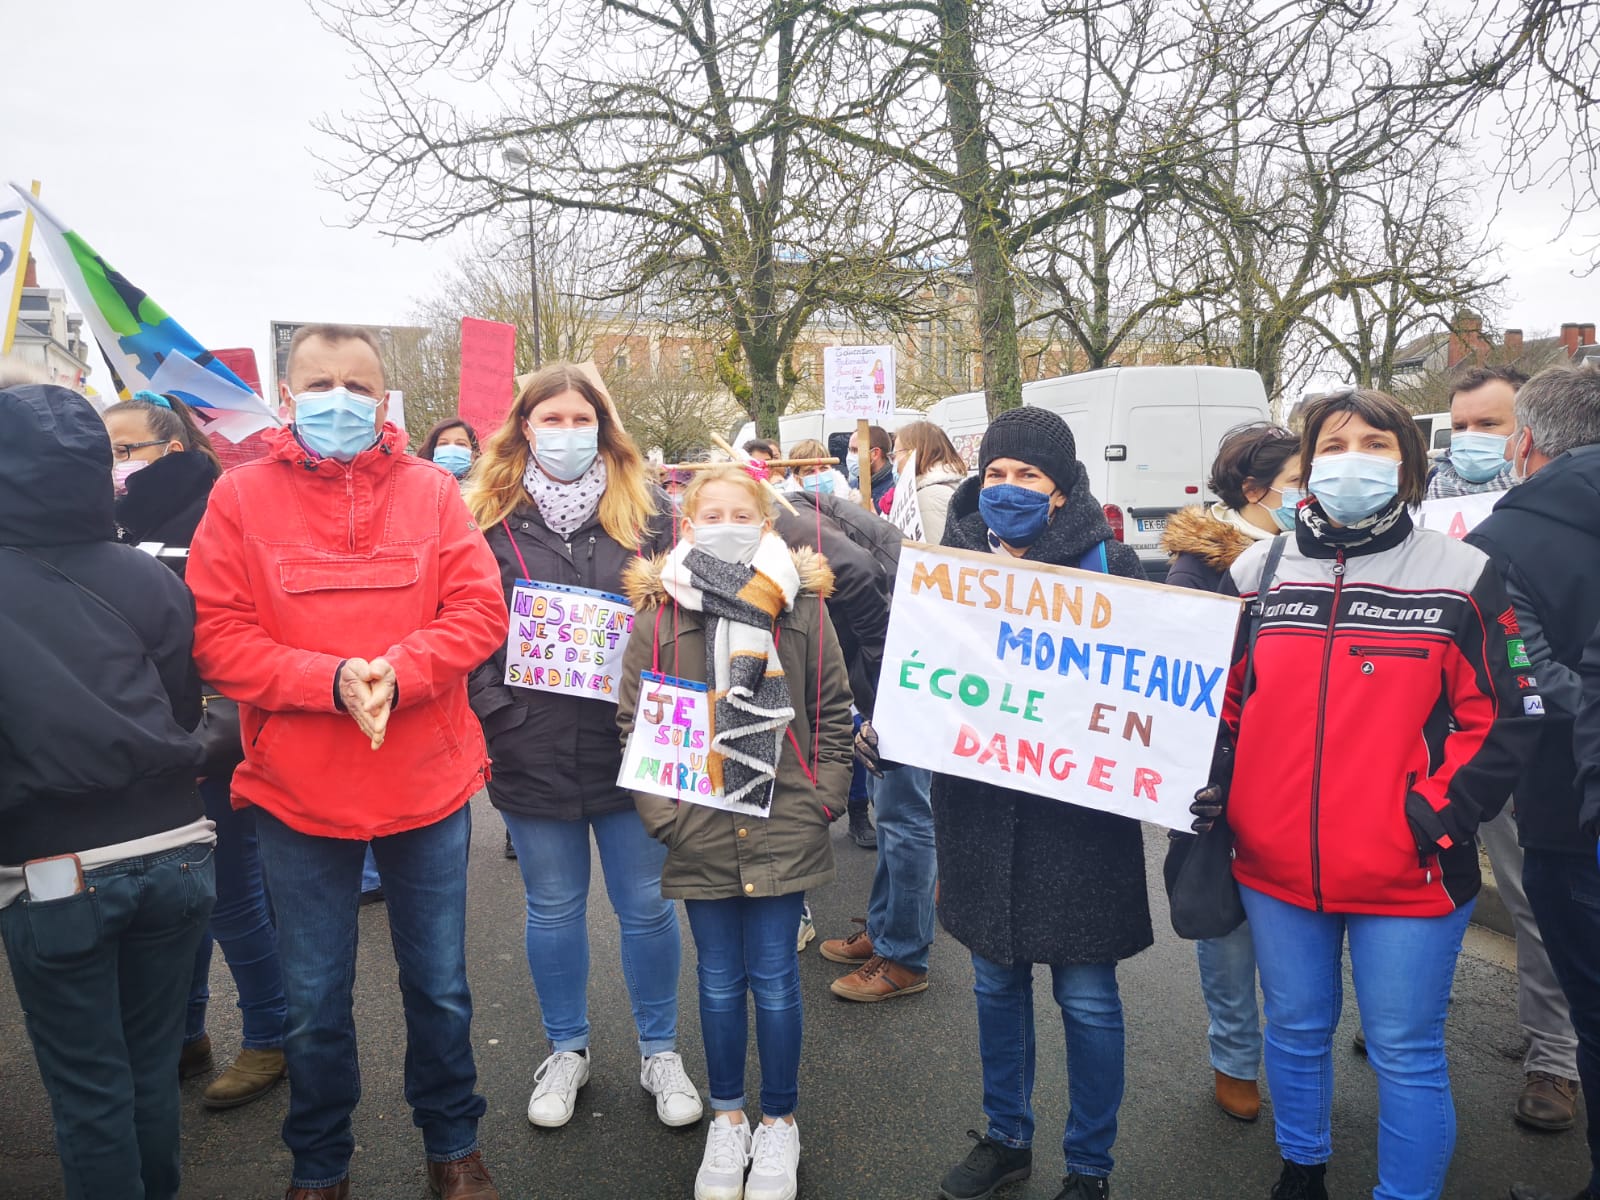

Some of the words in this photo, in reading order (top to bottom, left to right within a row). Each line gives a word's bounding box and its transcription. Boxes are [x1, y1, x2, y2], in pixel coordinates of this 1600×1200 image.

[513, 590, 566, 626] NOS
[910, 561, 1113, 629] MESLAND
[1348, 600, 1444, 624] Racing
[518, 620, 549, 642] NE
[557, 623, 621, 650] SONT
[520, 641, 556, 660] PAS
[565, 647, 605, 666] DES
[996, 621, 1225, 718] MONTEAUX
[643, 691, 696, 728] JE
[899, 650, 1046, 723] ÉCOLE
[1088, 702, 1153, 748] EN
[951, 723, 1164, 803] DANGER
